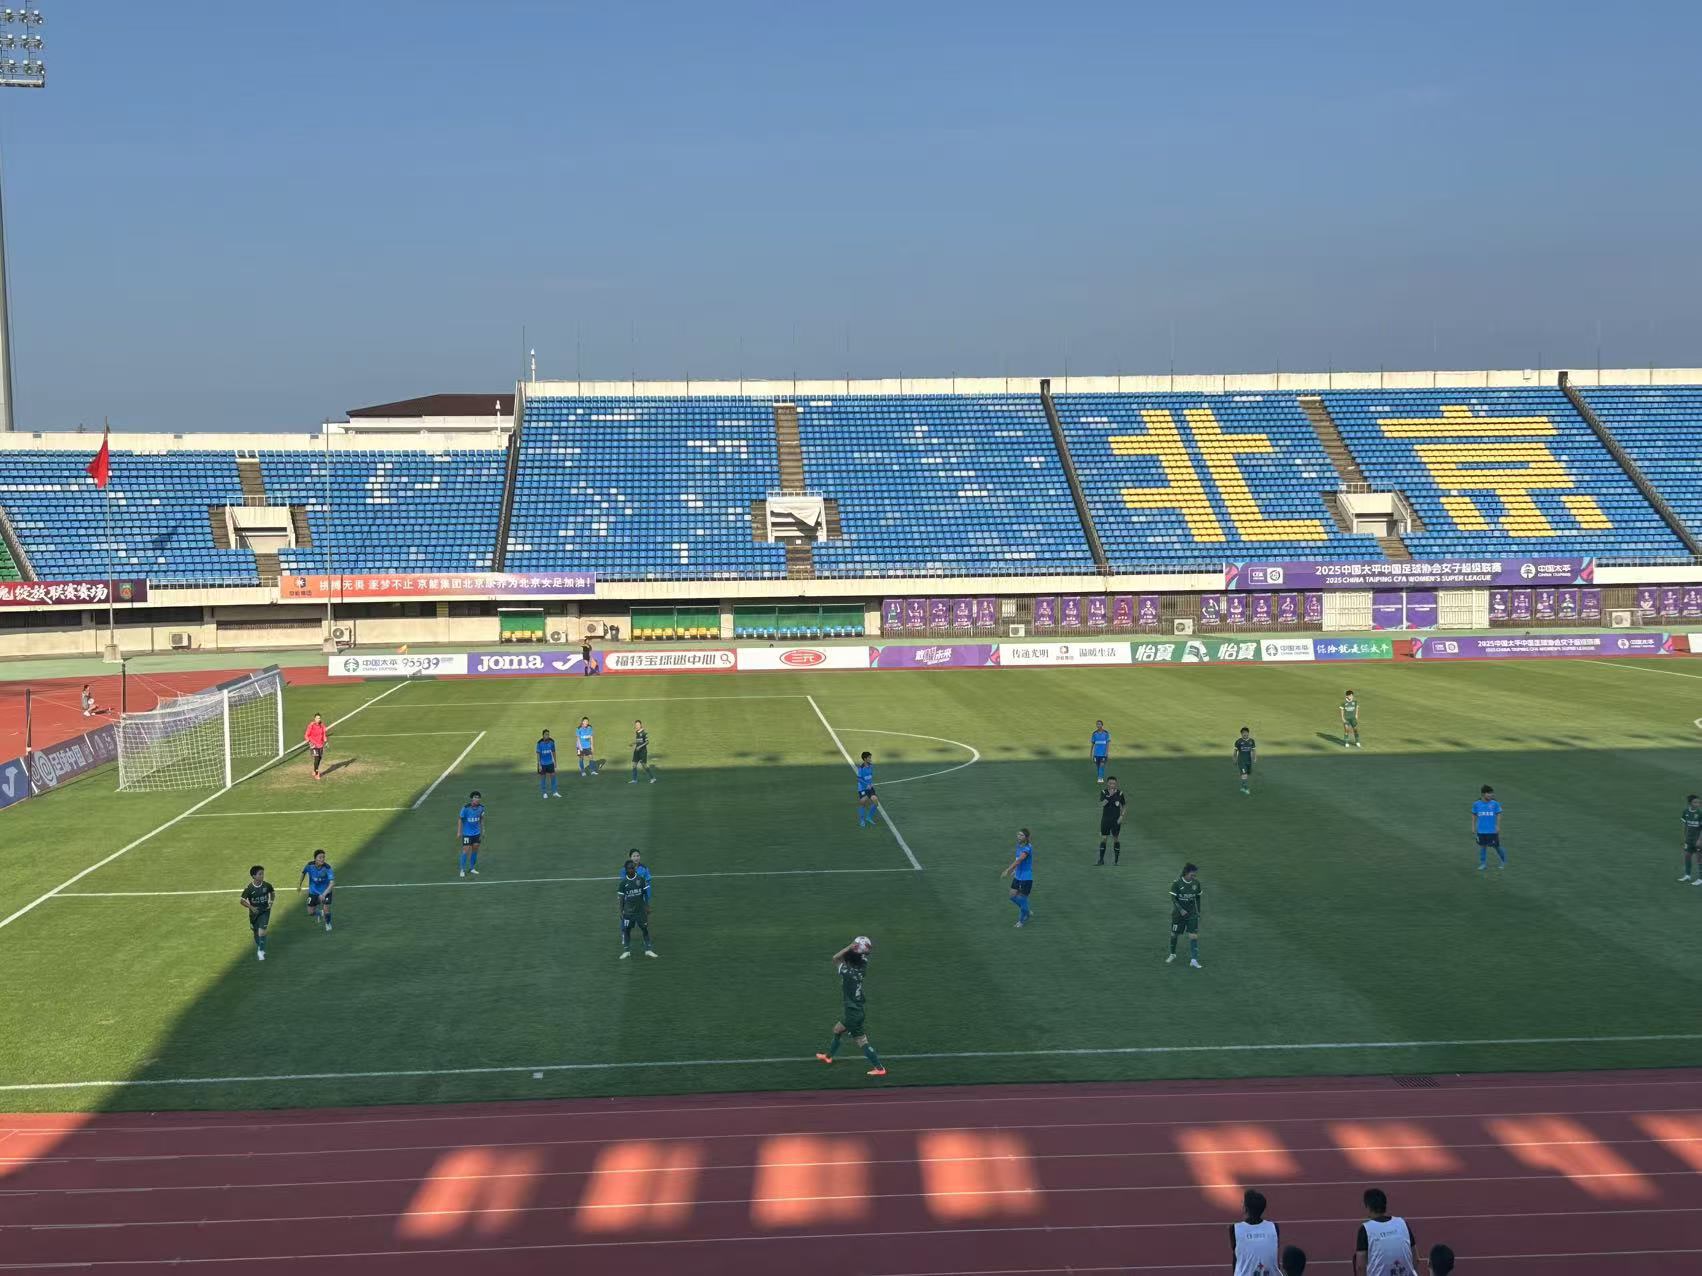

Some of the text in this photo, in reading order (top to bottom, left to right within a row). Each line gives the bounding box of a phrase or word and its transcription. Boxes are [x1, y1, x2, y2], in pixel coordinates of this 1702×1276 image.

[1108, 405, 1614, 541] 北京
[1315, 562, 1502, 576] 2025中国太平中国足球协会女子超级联赛
[1537, 564, 1571, 573] 中国太平
[615, 654, 716, 667] 福特宝球迷中心
